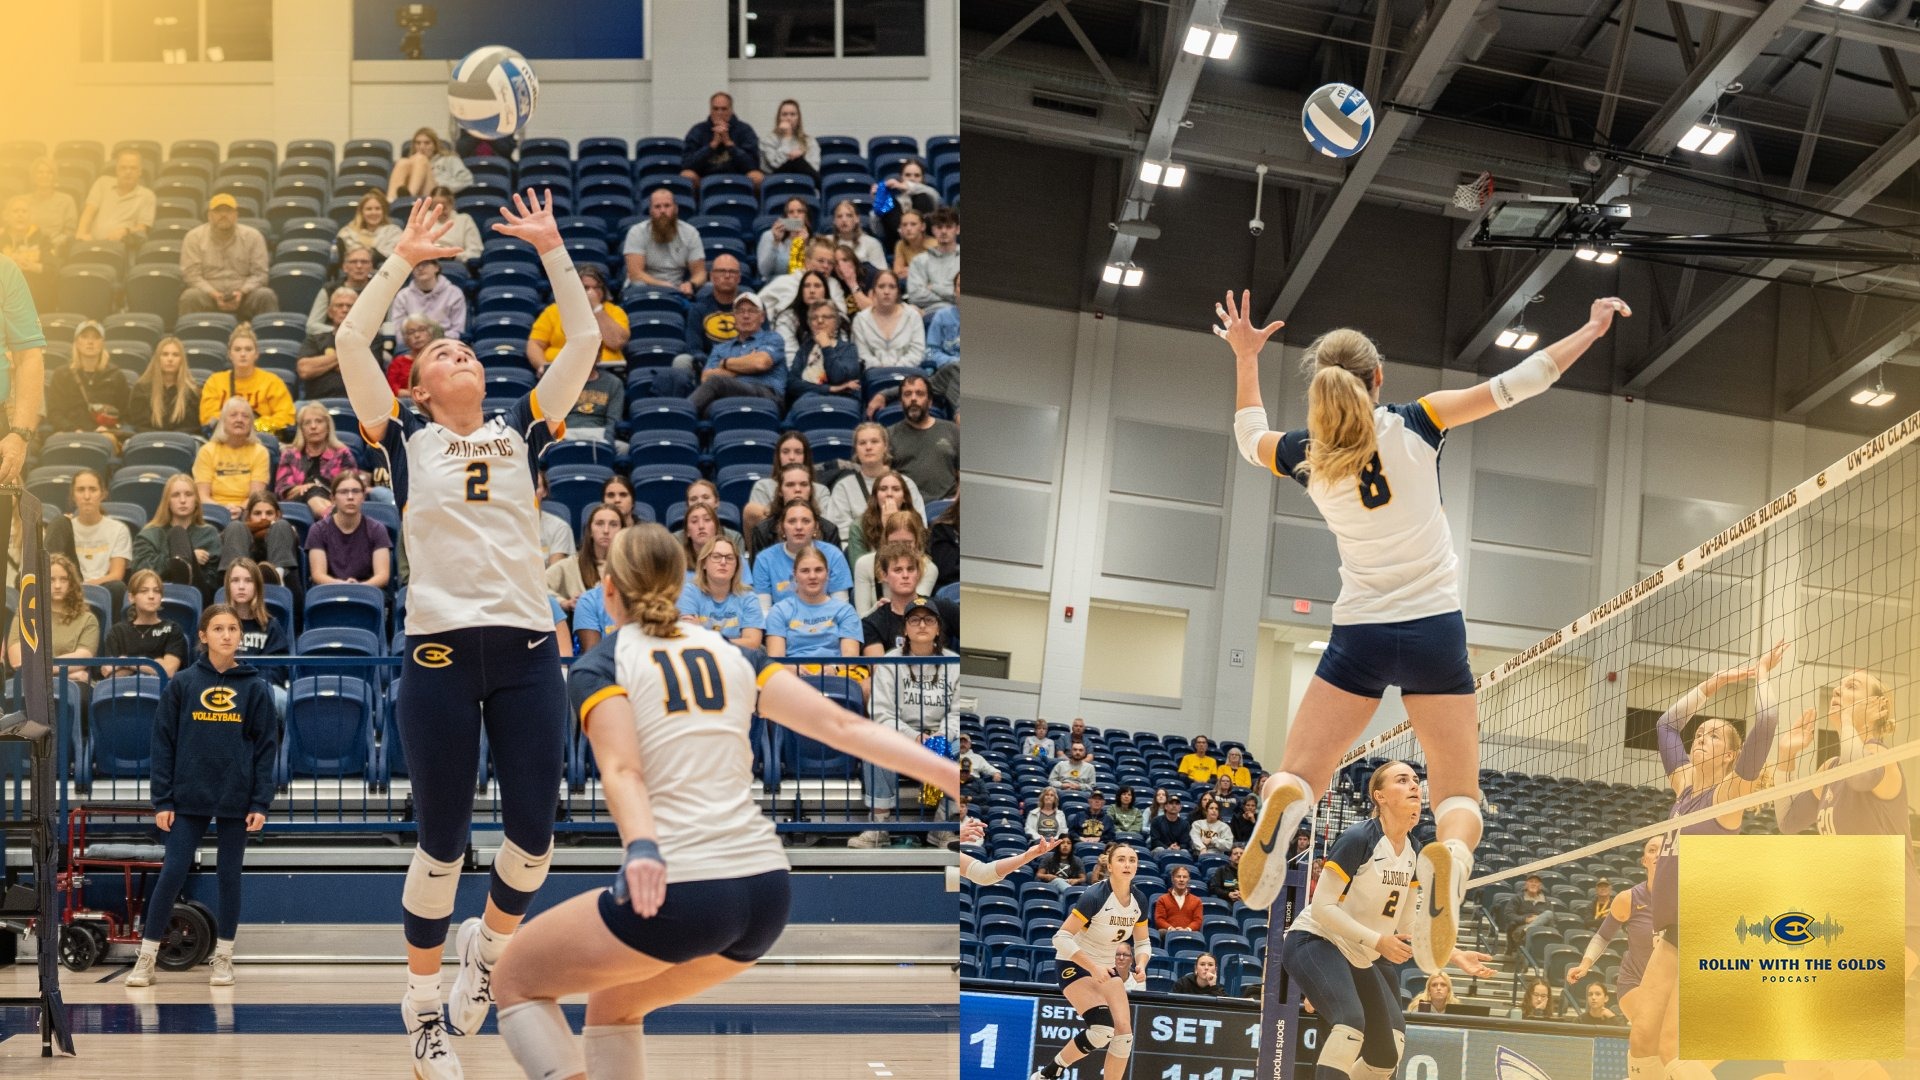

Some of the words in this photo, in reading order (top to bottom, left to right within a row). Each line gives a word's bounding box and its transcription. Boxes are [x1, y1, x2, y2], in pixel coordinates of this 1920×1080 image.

[1847, 434, 1885, 471] UW-EAU
[465, 461, 490, 502] 2
[1358, 450, 1392, 510] 8
[1729, 513, 1757, 542] CLAIRE
[1758, 489, 1797, 525] BLUGOLDS
[243, 632, 268, 649] CITY
[651, 647, 728, 714] 10
[192, 711, 243, 723] VOLLEYBALL
[1382, 890, 1400, 918] 2
[969, 1024, 998, 1069] 1
[1151, 1015, 1222, 1045] SET
[1276, 1019, 1285, 1048] sports
[1272, 1049, 1283, 1080] import
